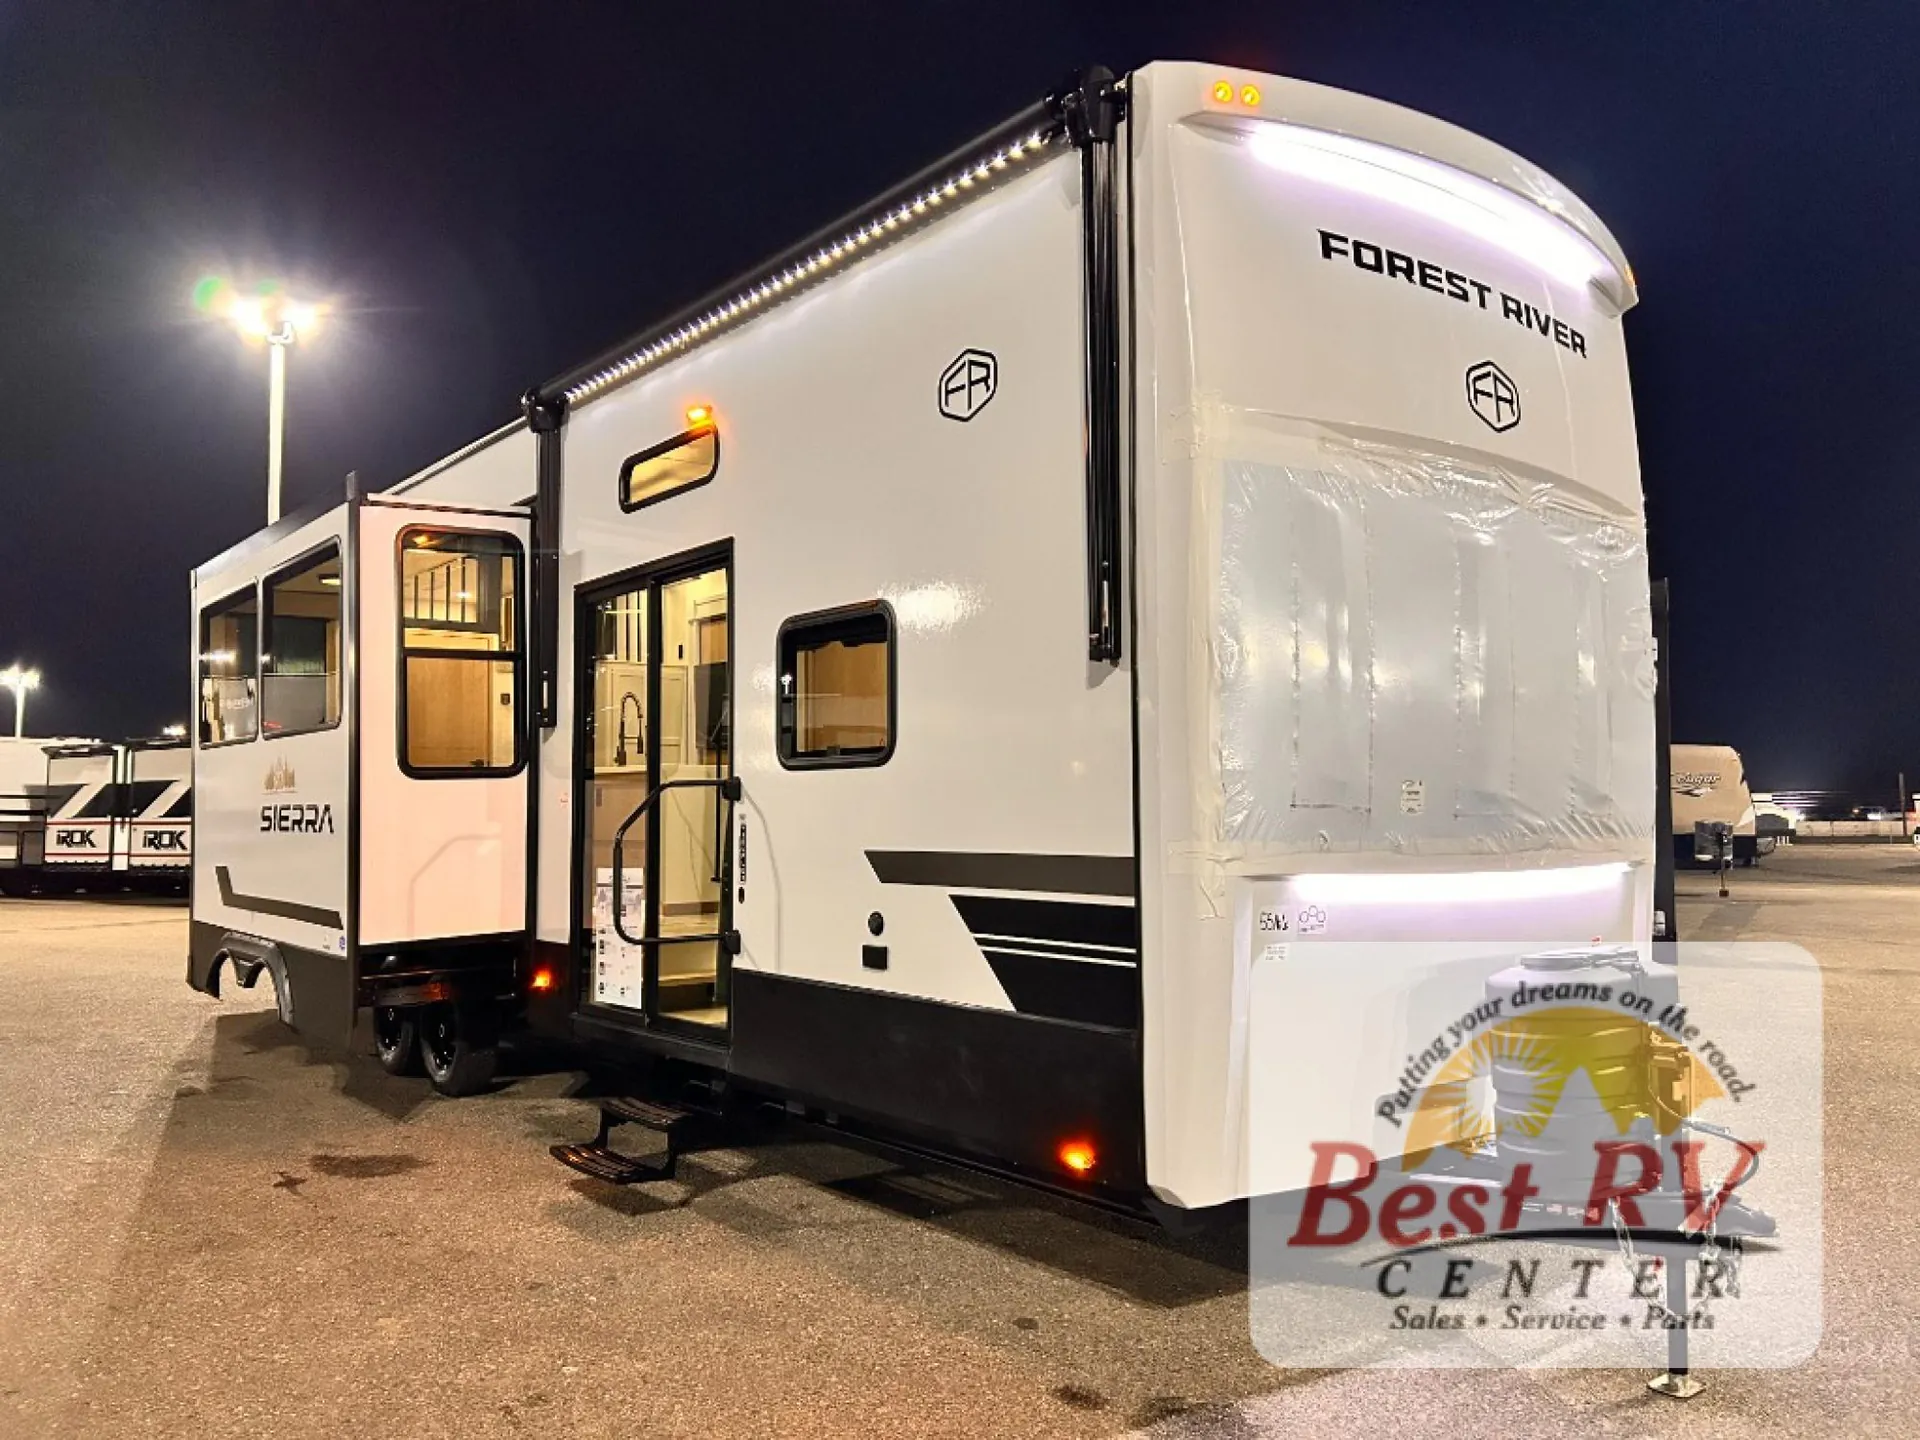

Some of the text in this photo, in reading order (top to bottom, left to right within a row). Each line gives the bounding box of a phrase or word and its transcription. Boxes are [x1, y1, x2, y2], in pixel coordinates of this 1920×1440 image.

[1317, 228, 1587, 359] FOREST RIVER
[260, 804, 334, 834] SIERRA
